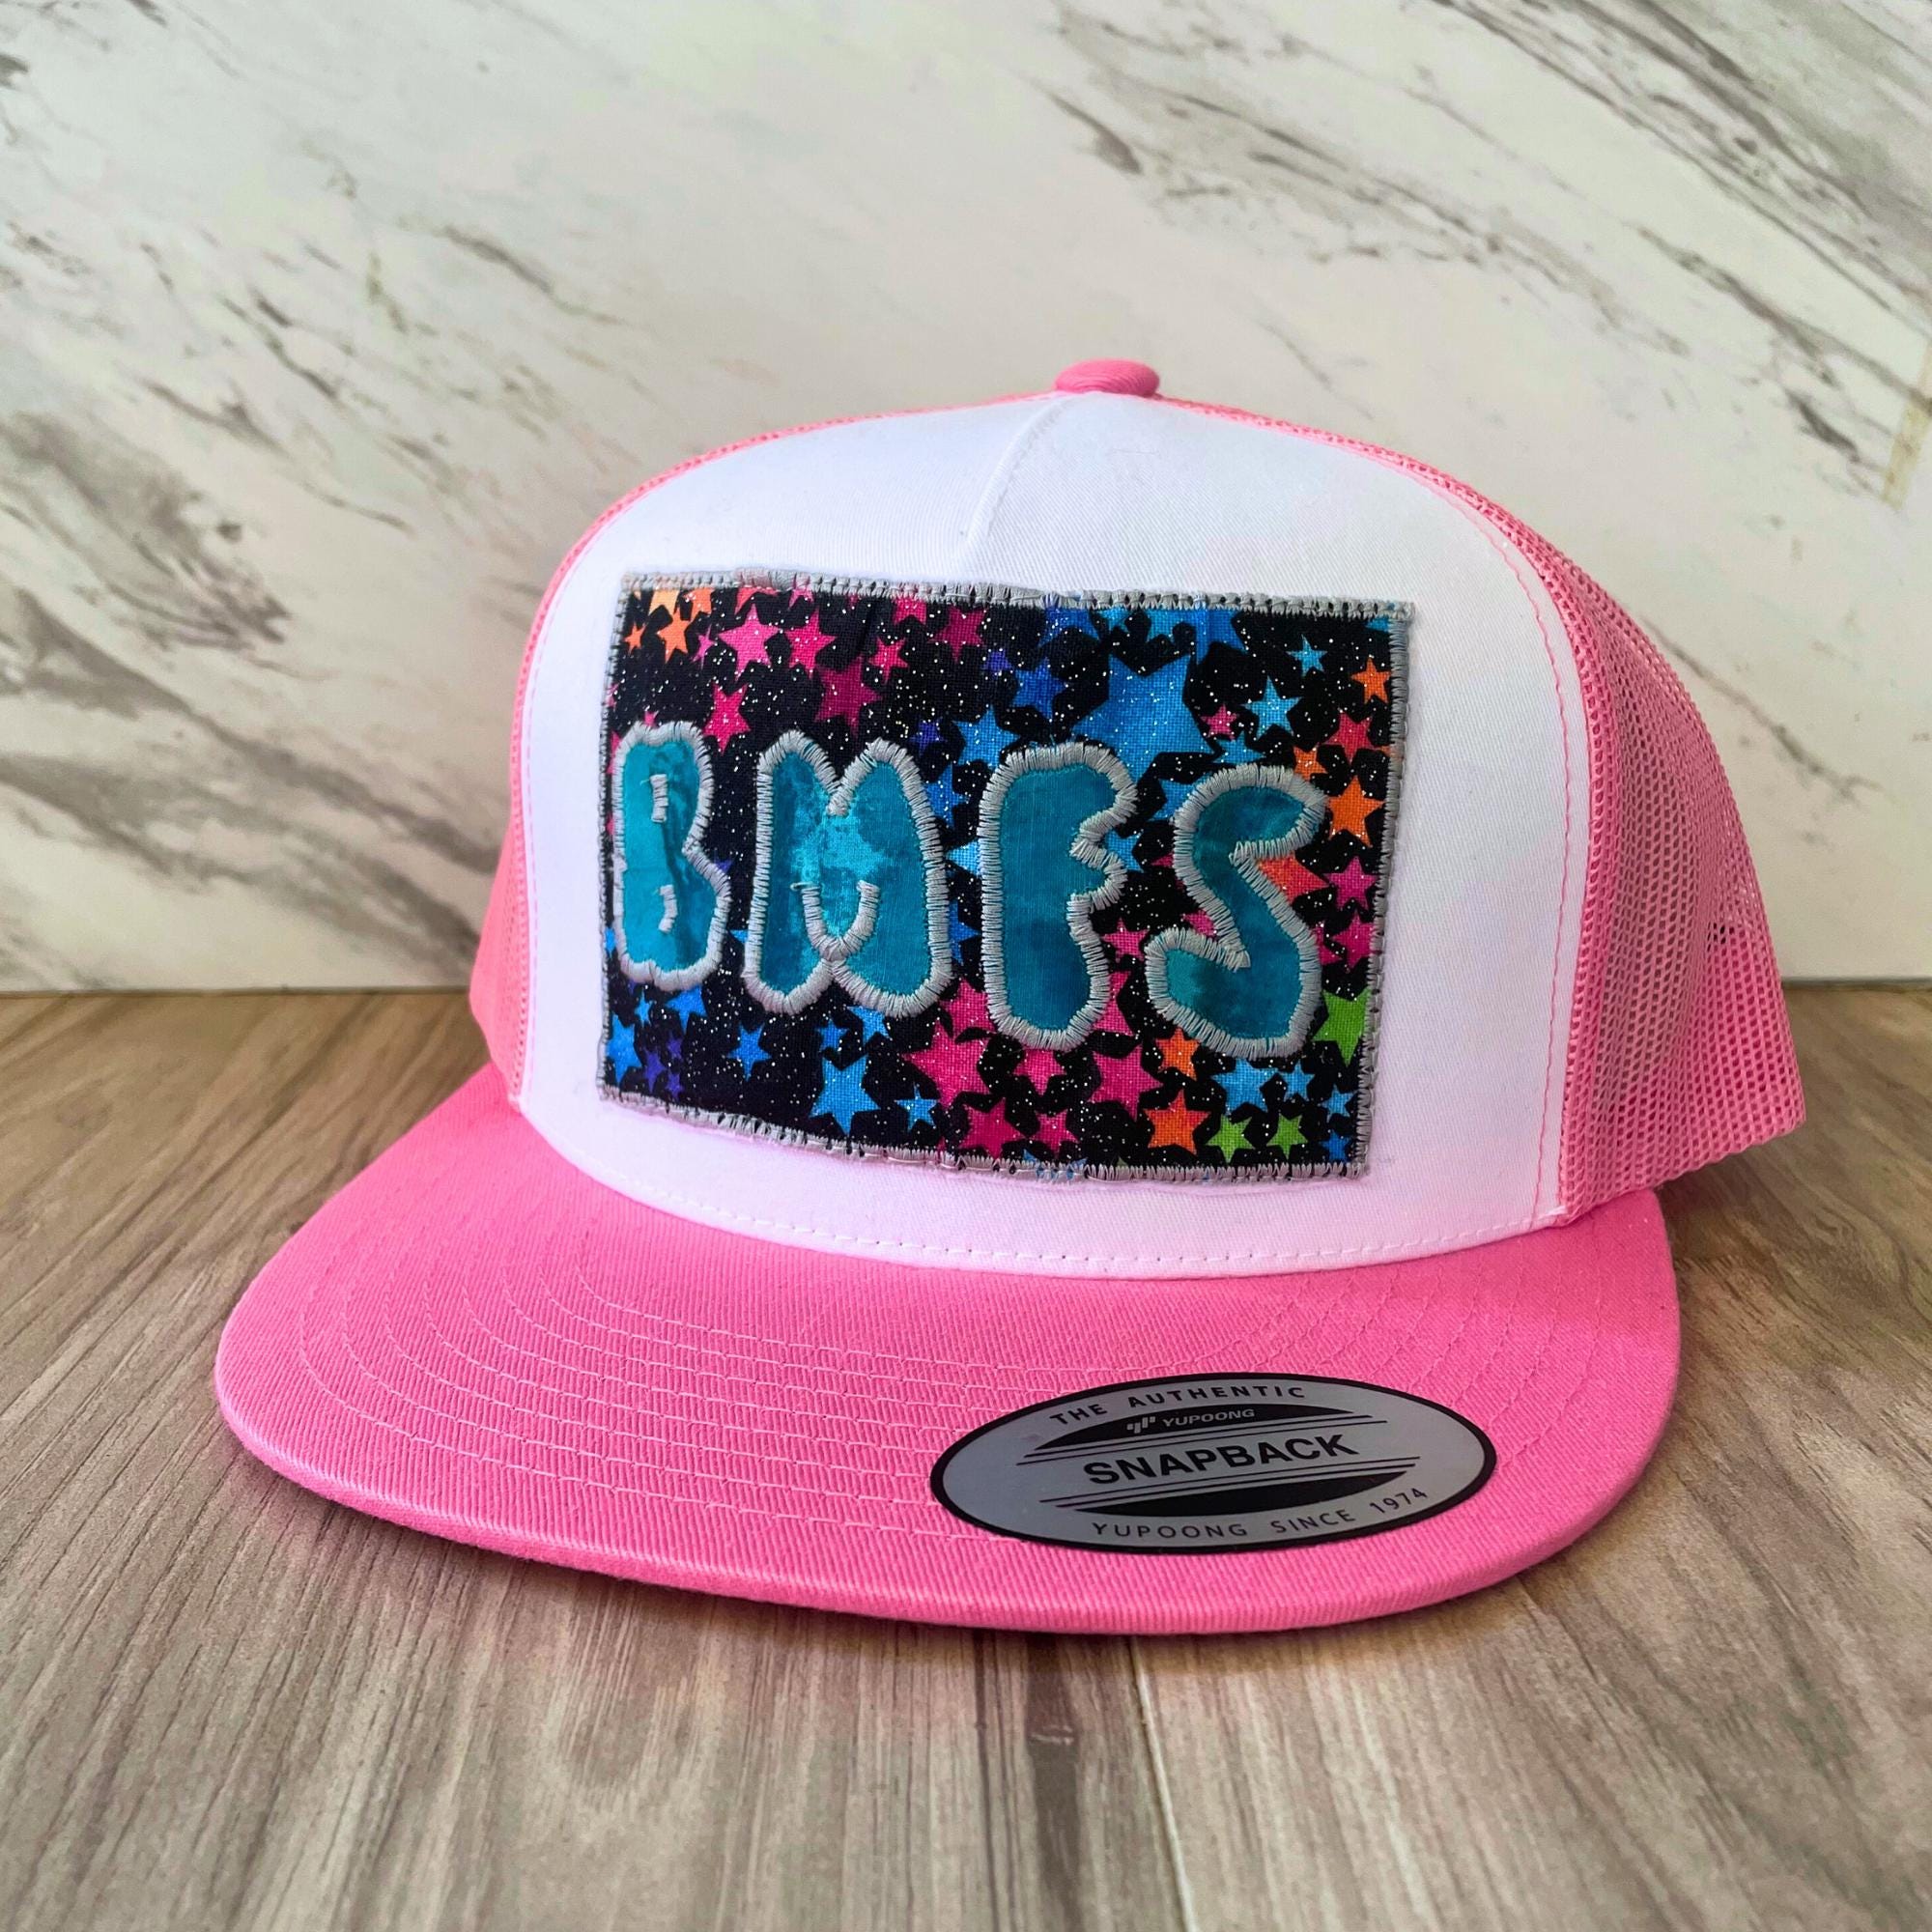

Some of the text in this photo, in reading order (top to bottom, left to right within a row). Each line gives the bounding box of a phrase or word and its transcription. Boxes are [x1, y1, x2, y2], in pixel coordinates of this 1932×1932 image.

[611, 719, 1329, 1060] BMFS
[1049, 1385, 1305, 1426] THE AUTHENTIC
[1163, 1408, 1255, 1427] YUPOONG
[1083, 1435, 1359, 1485] SNAPBACK
[1093, 1486, 1428, 1539] YUPOONG SINCE 1974
